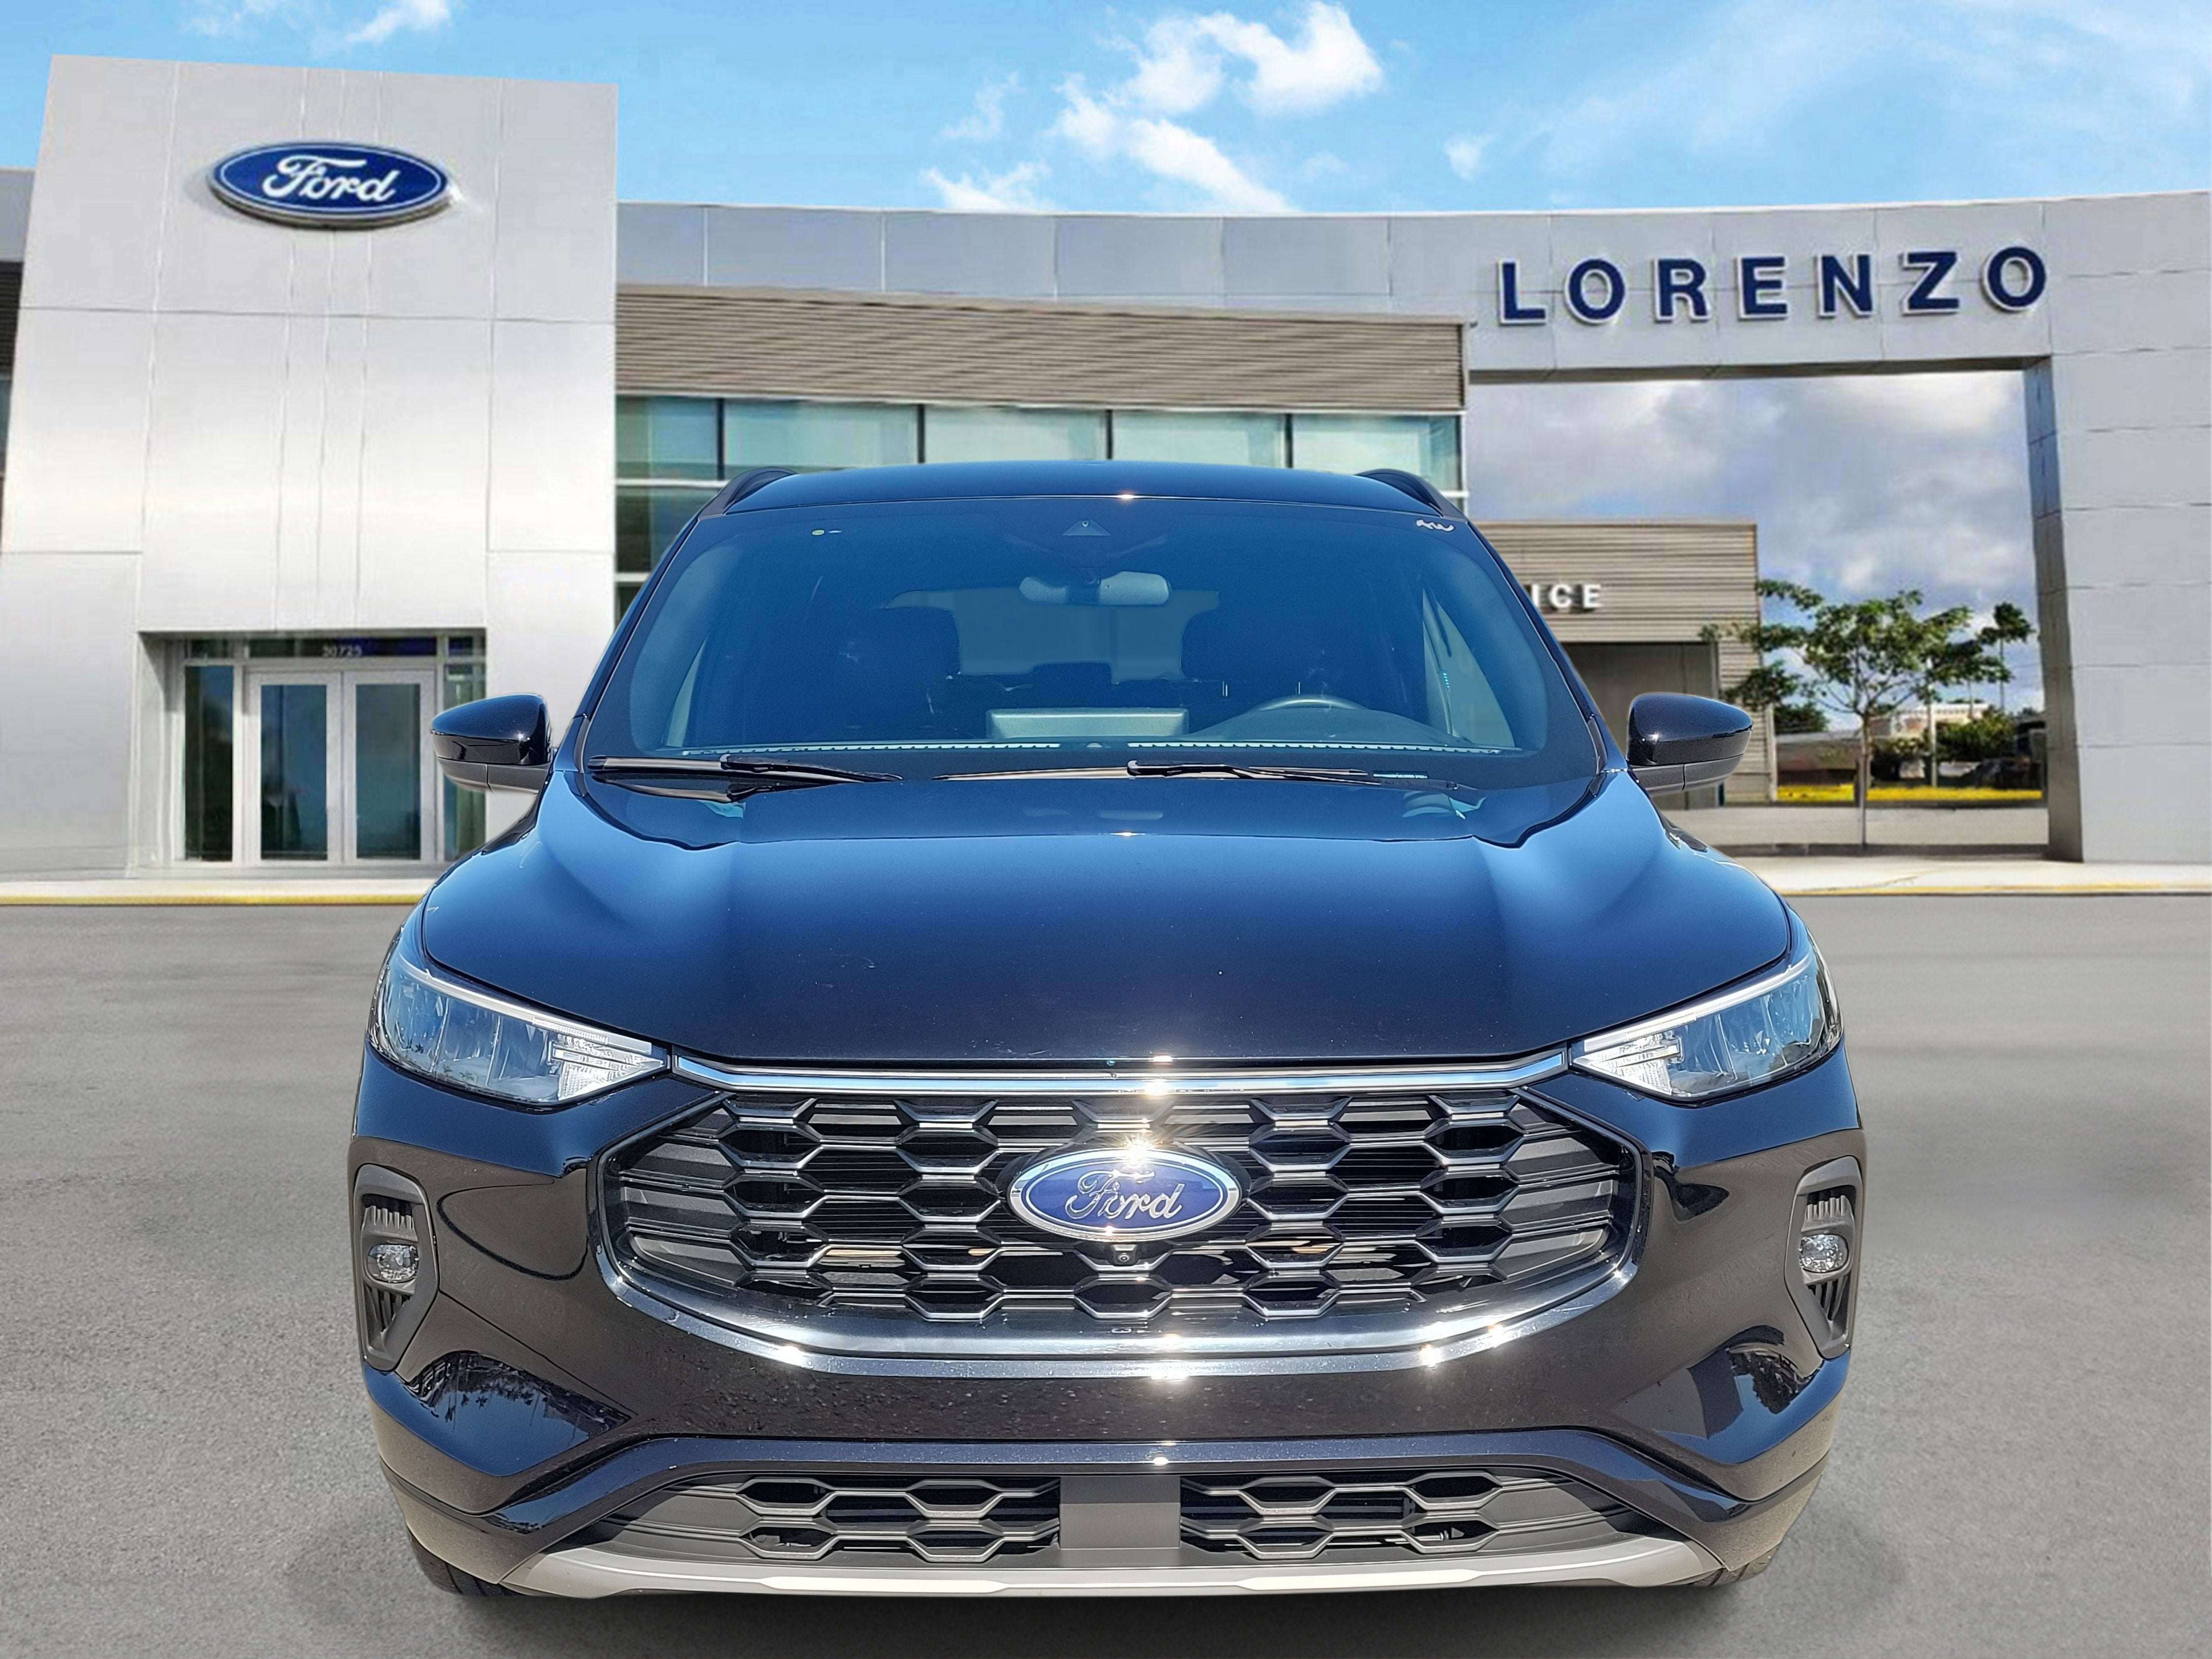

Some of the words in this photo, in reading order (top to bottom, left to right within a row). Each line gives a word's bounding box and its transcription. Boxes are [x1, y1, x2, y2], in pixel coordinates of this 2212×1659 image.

[262, 154, 400, 201] Ford
[1498, 246, 2048, 324] LORENZO
[1065, 1169, 1185, 1220] Ford
